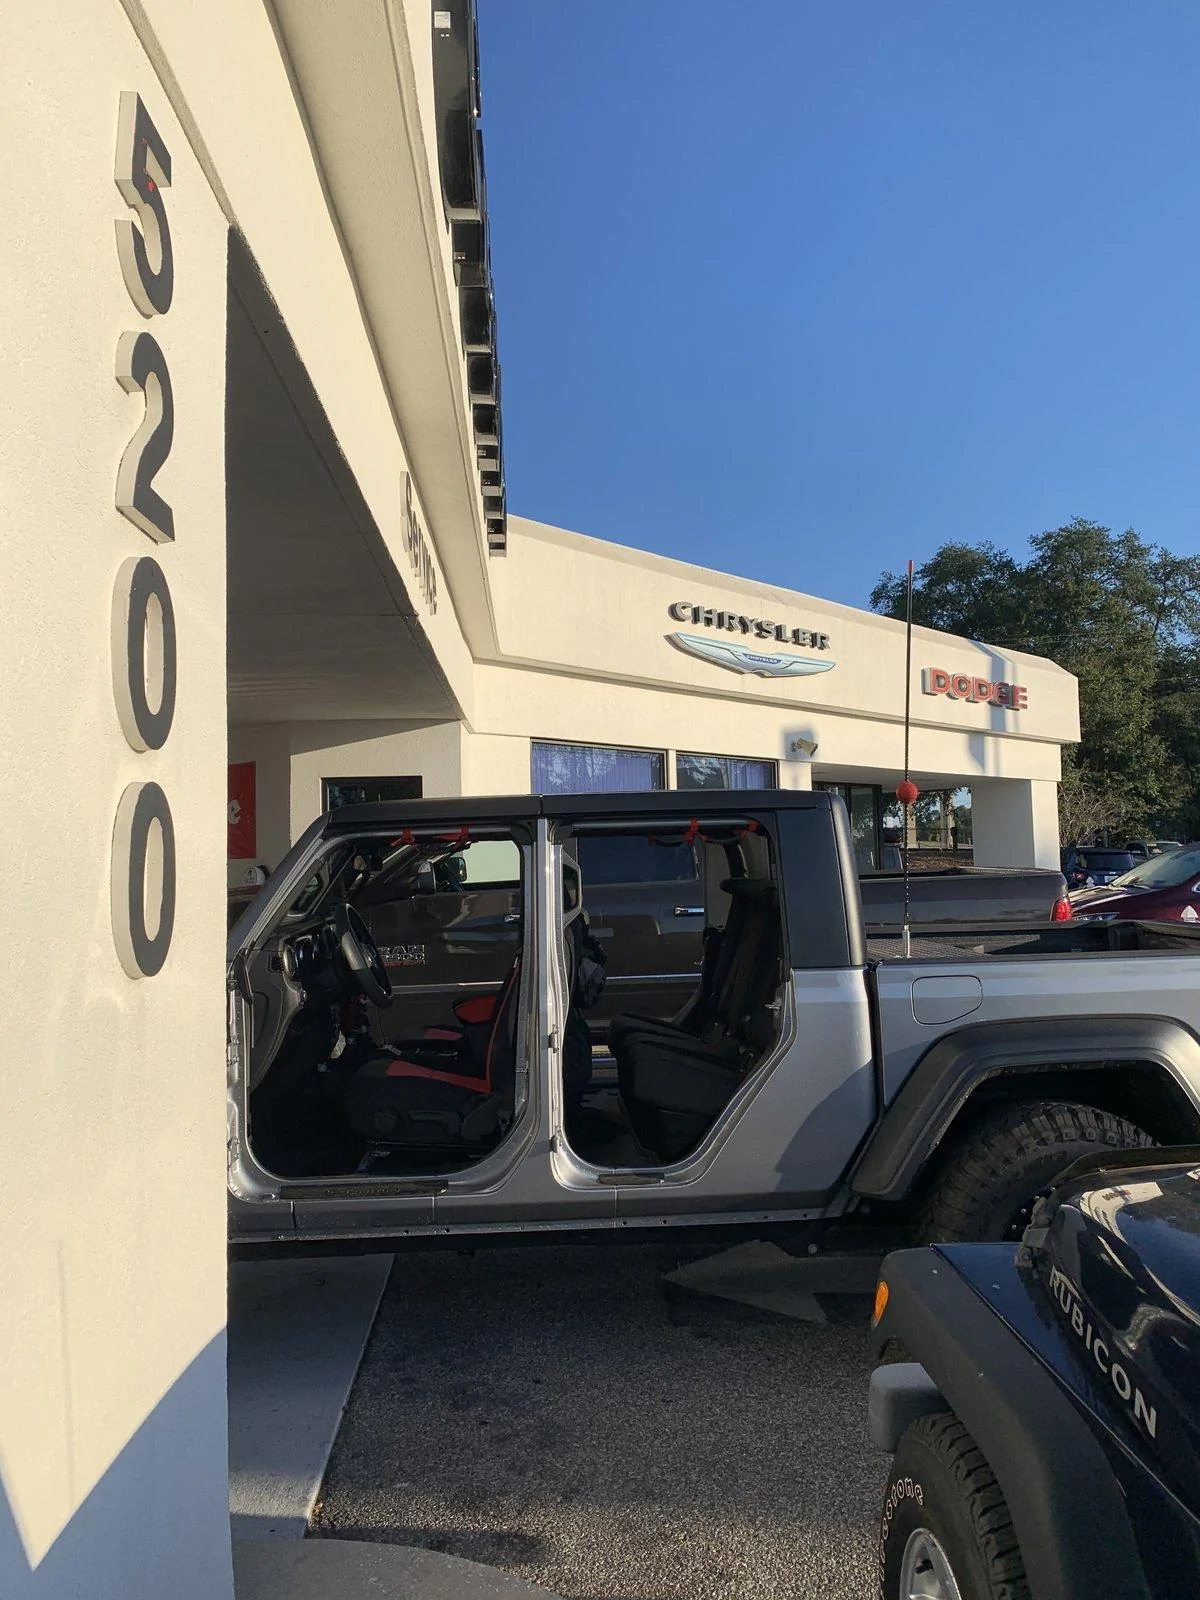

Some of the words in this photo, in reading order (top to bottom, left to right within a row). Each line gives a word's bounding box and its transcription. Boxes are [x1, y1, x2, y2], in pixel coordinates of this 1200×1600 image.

[112, 91, 176, 980] 5200
[668, 601, 831, 650] CHRYSLER
[746, 654, 779, 664] CHRYSLER
[921, 667, 1028, 711] DODGE
[1050, 1265, 1157, 1438] RUBICON
